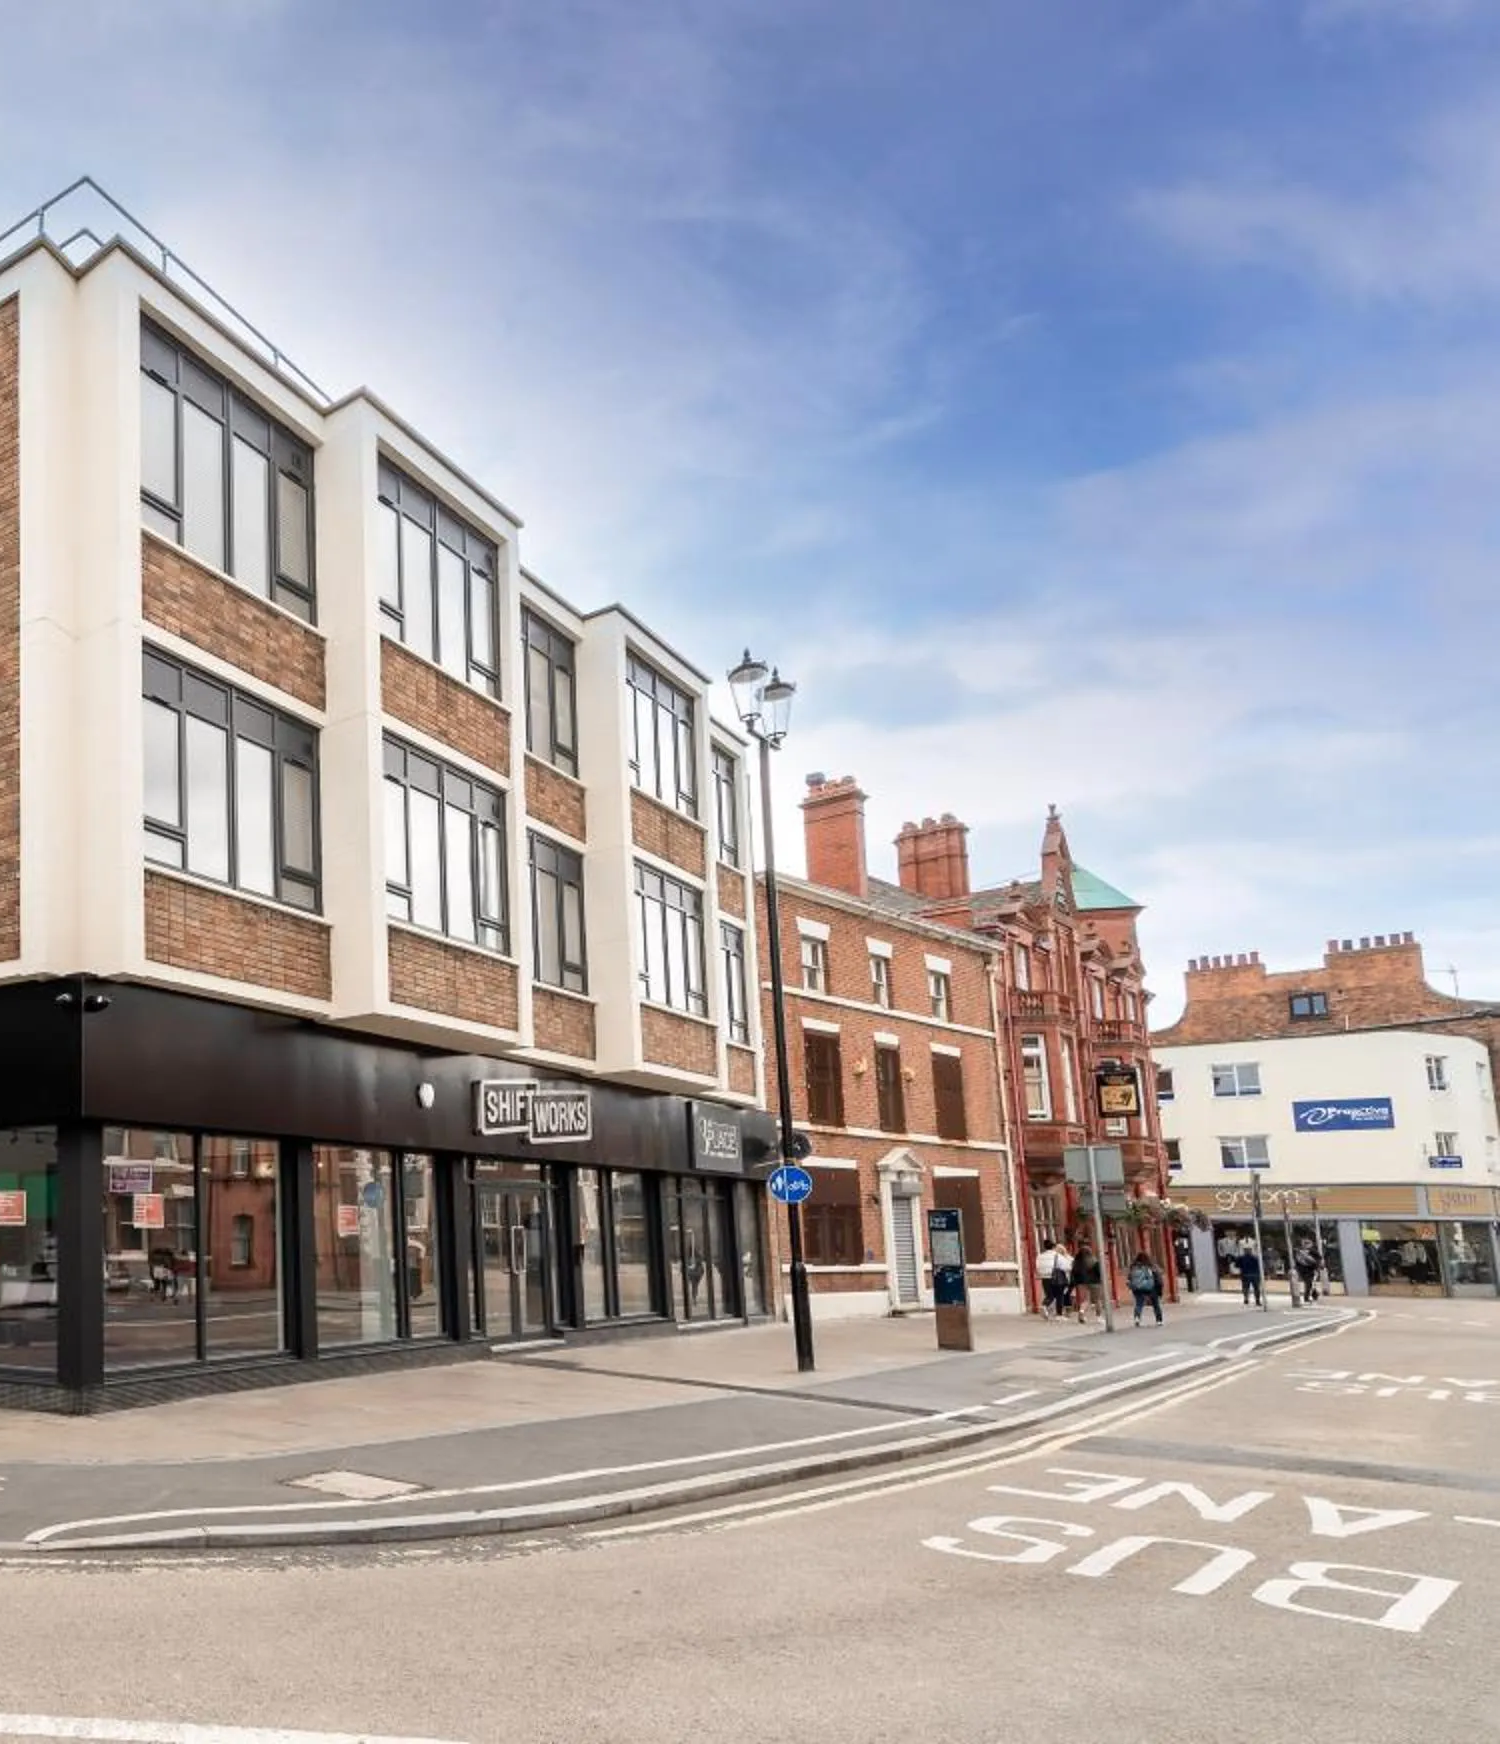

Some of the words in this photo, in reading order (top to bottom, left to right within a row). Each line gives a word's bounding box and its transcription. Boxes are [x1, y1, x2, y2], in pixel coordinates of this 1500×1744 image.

[486, 1090, 534, 1123] SHIFT
[534, 1101, 587, 1133] WORKS
[920, 1515, 1462, 1633] BUS
